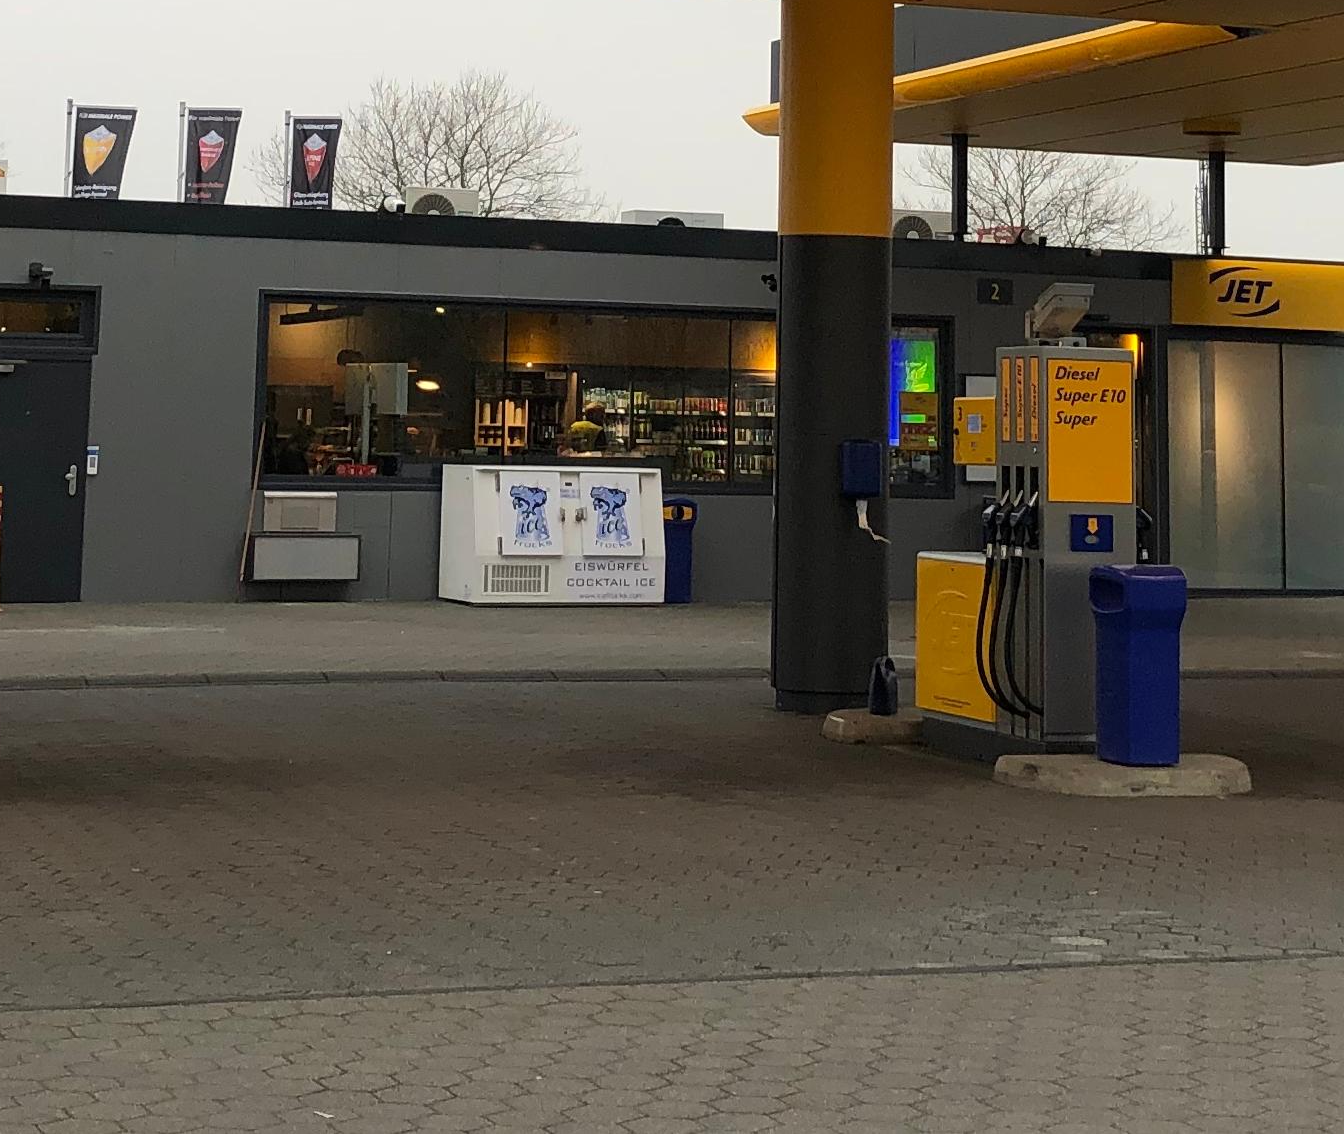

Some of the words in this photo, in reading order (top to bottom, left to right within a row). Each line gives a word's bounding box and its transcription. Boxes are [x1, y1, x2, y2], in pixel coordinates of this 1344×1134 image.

[991, 283, 1000, 301] 2
[1216, 279, 1273, 304] JET
[1055, 365, 1101, 381] Diesel
[1054, 387, 1098, 407] Super
[1099, 388, 1126, 404] E10
[1054, 410, 1098, 430] Super
[574, 560, 649, 571] EISWÜRFEL
[566, 577, 631, 587] COCKTAIL
[635, 577, 656, 587] ICE
